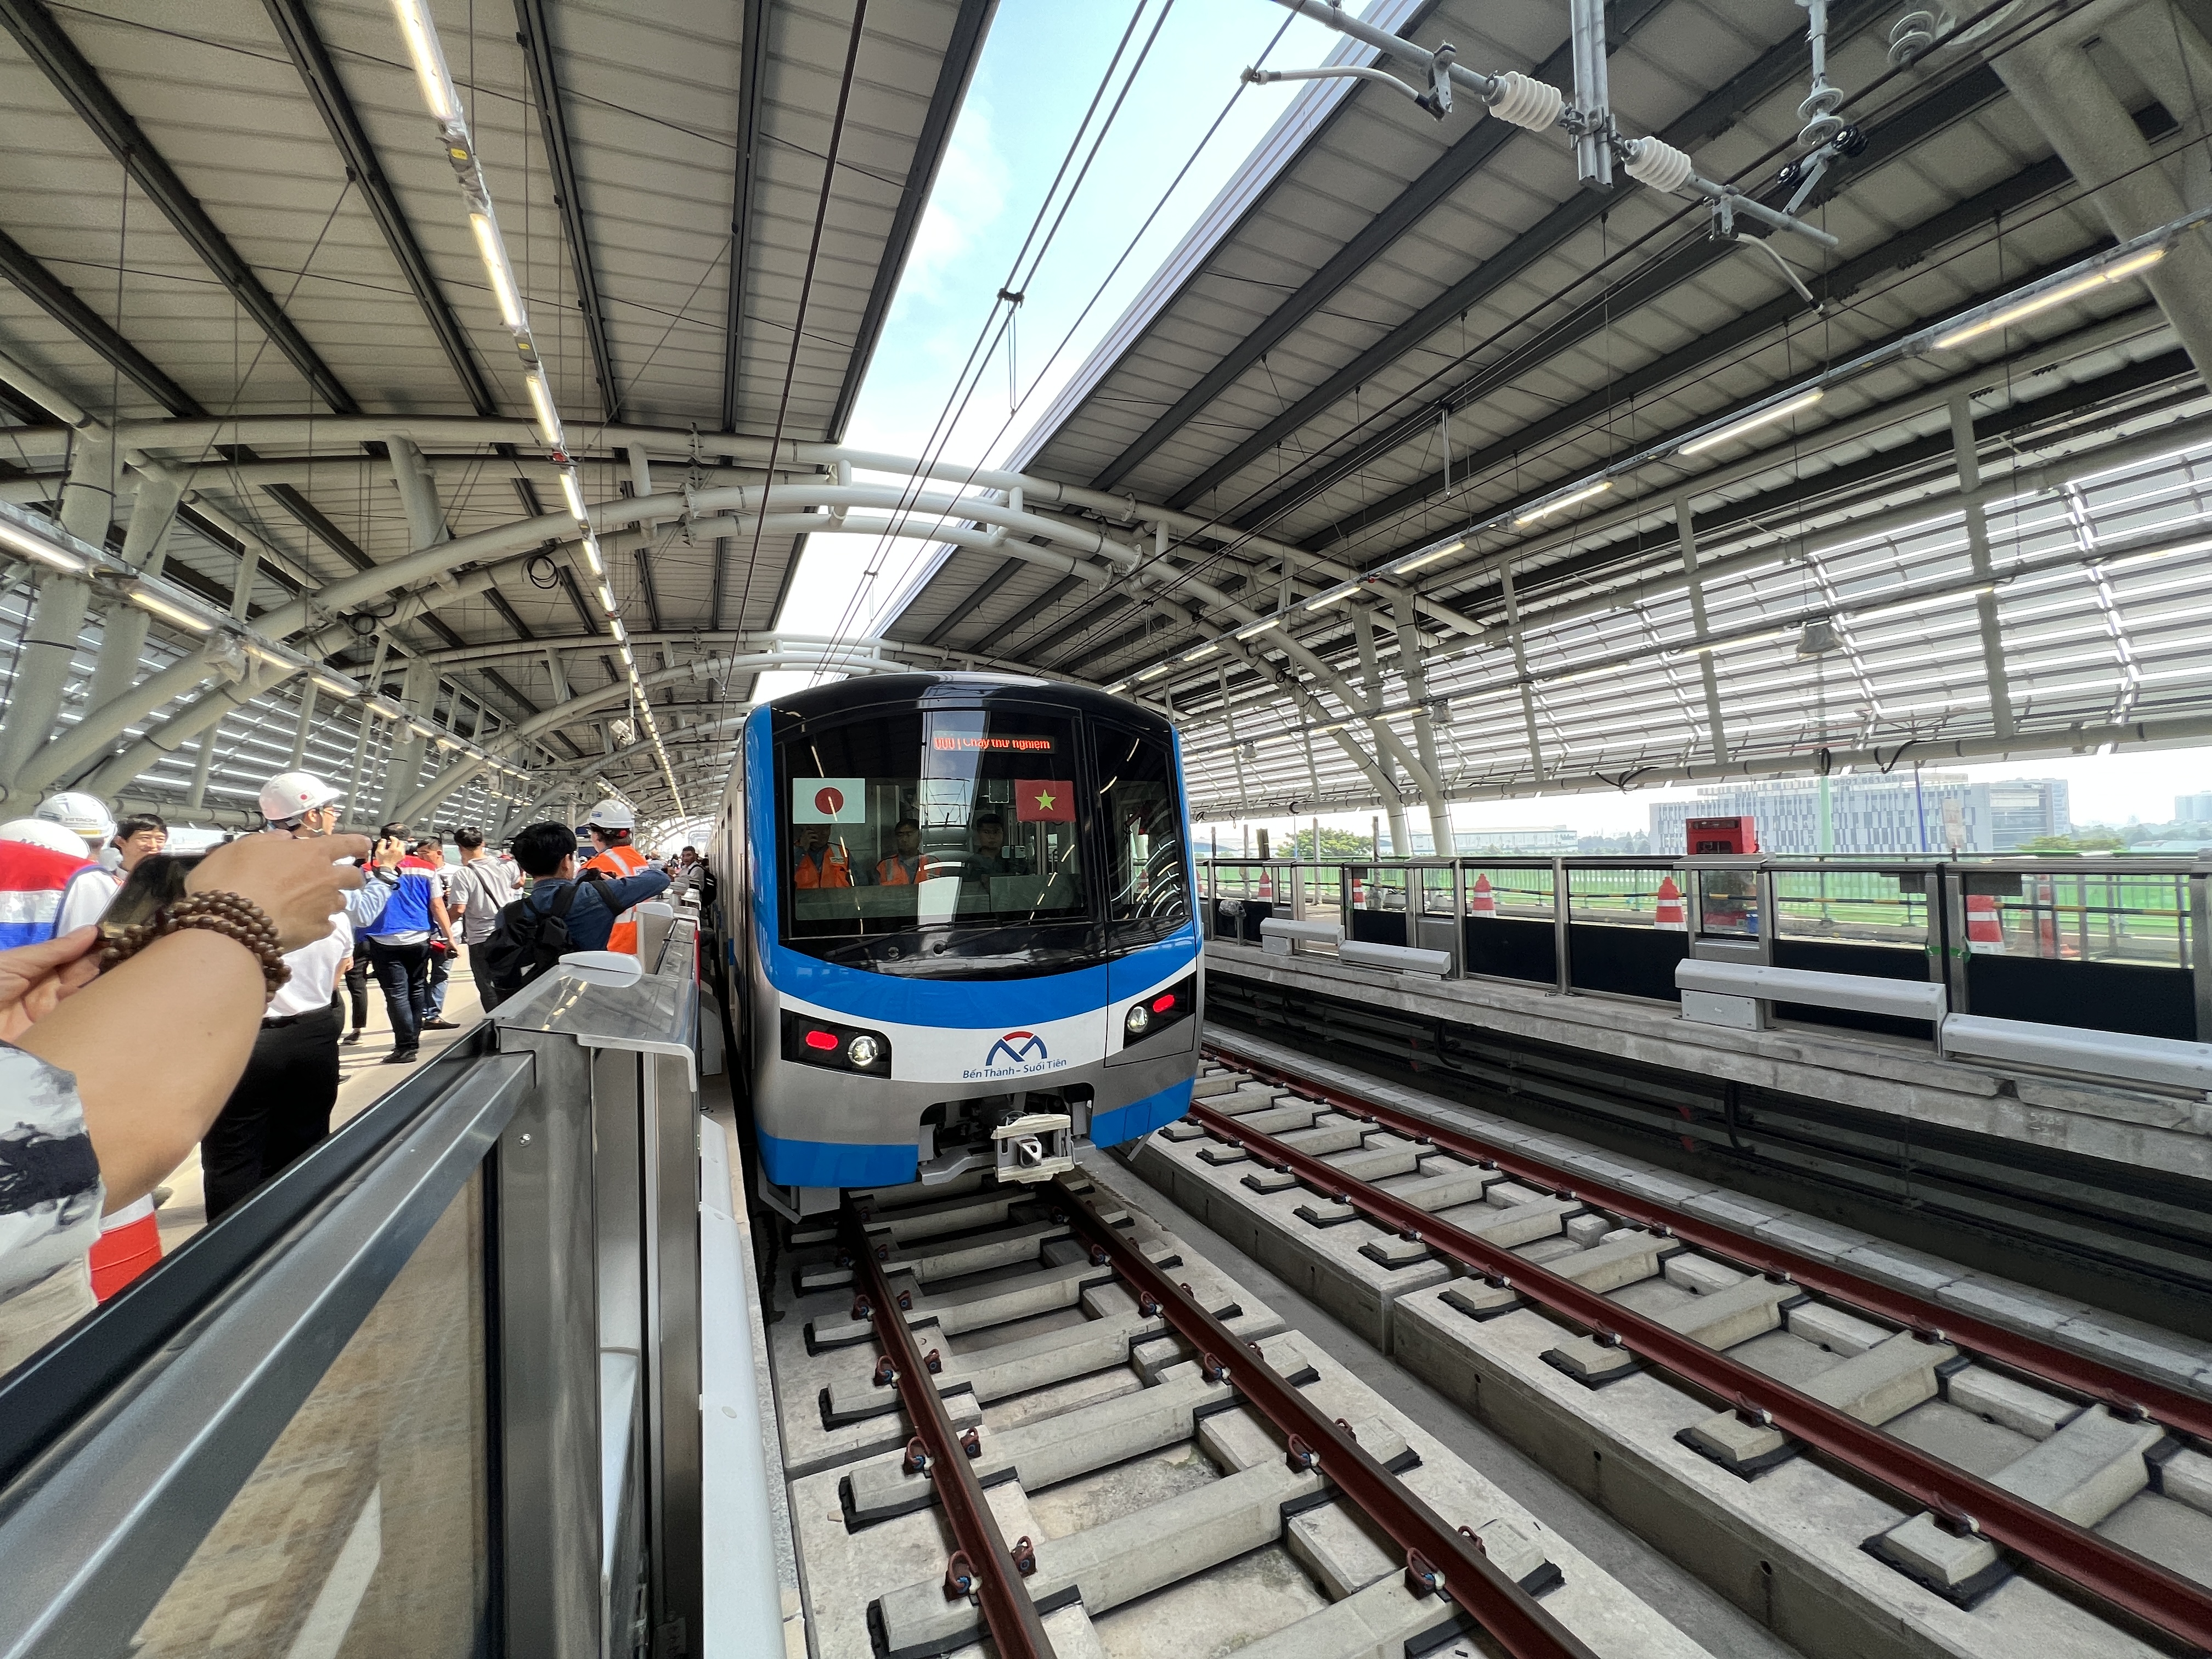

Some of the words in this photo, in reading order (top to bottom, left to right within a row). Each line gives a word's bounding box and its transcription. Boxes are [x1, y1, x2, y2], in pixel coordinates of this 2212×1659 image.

[963, 1068, 982, 1079] Bến
[984, 1066, 1014, 1077] Thành
[1024, 1061, 1045, 1073] Suối
[1047, 1058, 1066, 1069] Tiên
